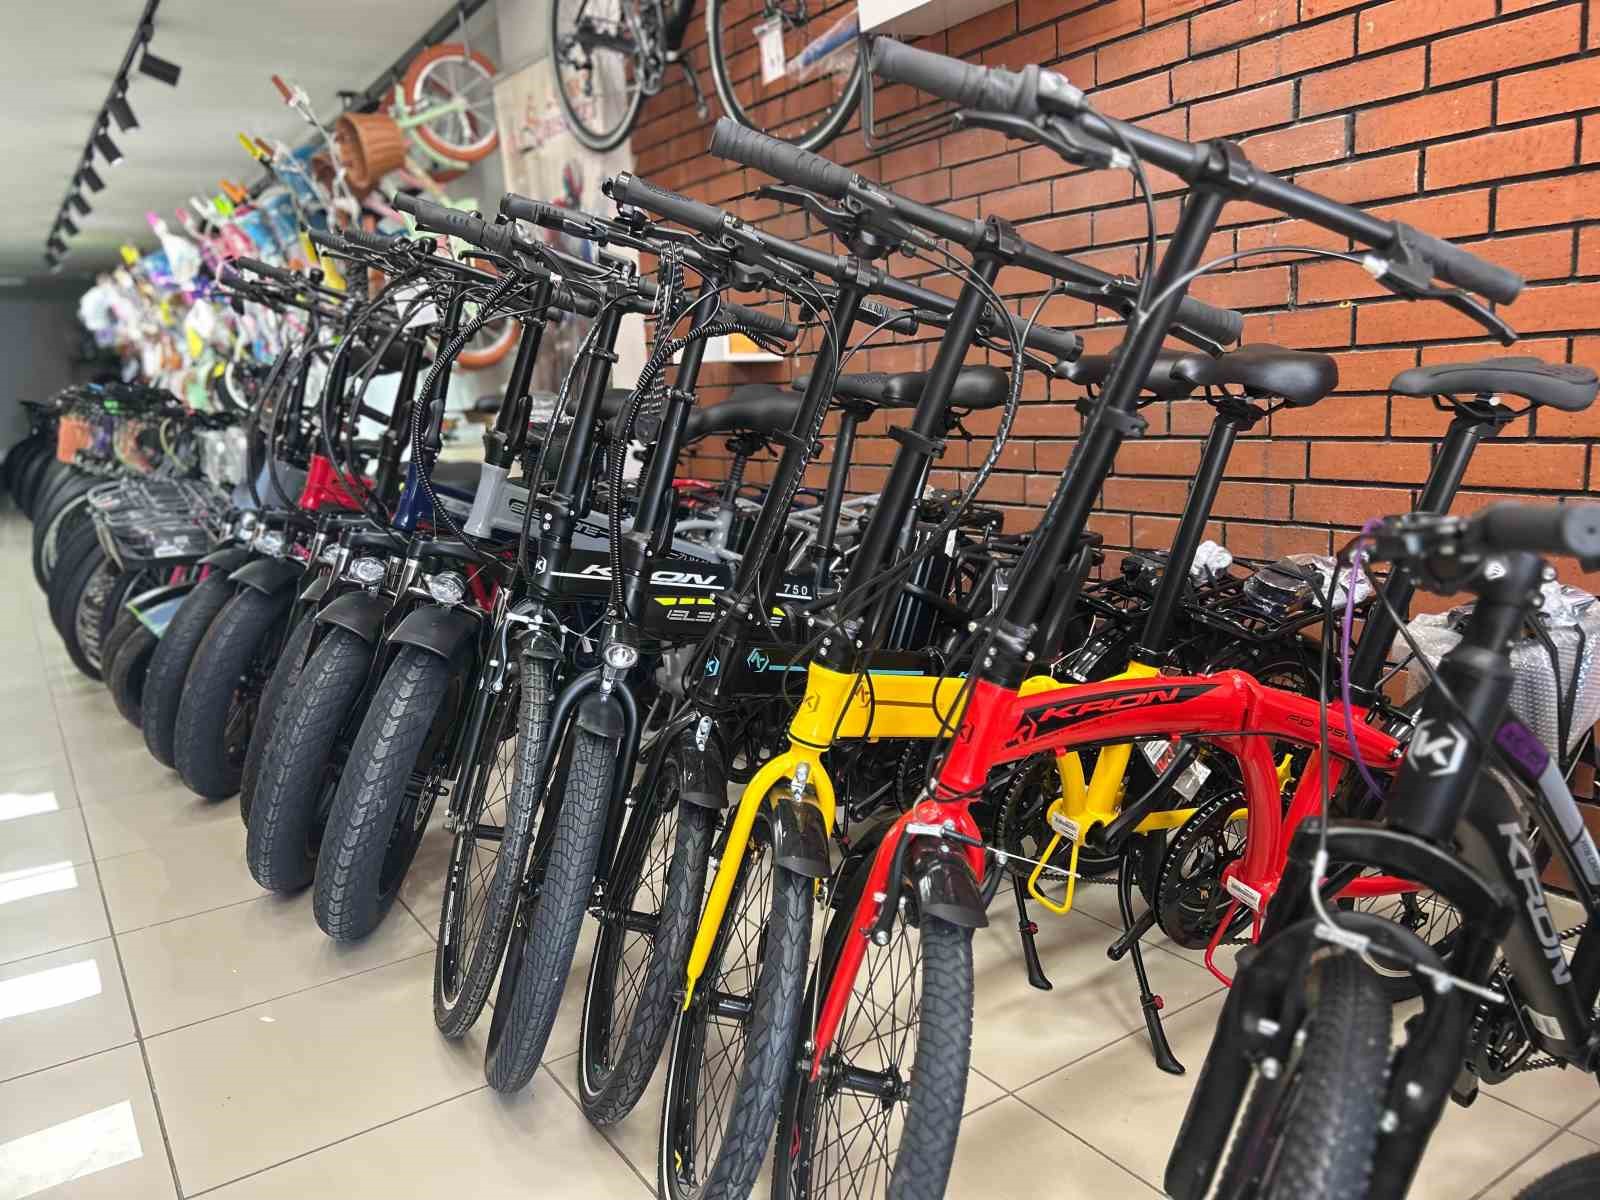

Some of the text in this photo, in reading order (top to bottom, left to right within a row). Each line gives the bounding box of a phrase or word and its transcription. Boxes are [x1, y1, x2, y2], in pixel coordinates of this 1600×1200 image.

[580, 564, 717, 585] KON
[784, 583, 808, 596] 750
[1039, 687, 1181, 722] KRON
[1497, 822, 1572, 986] KRON
